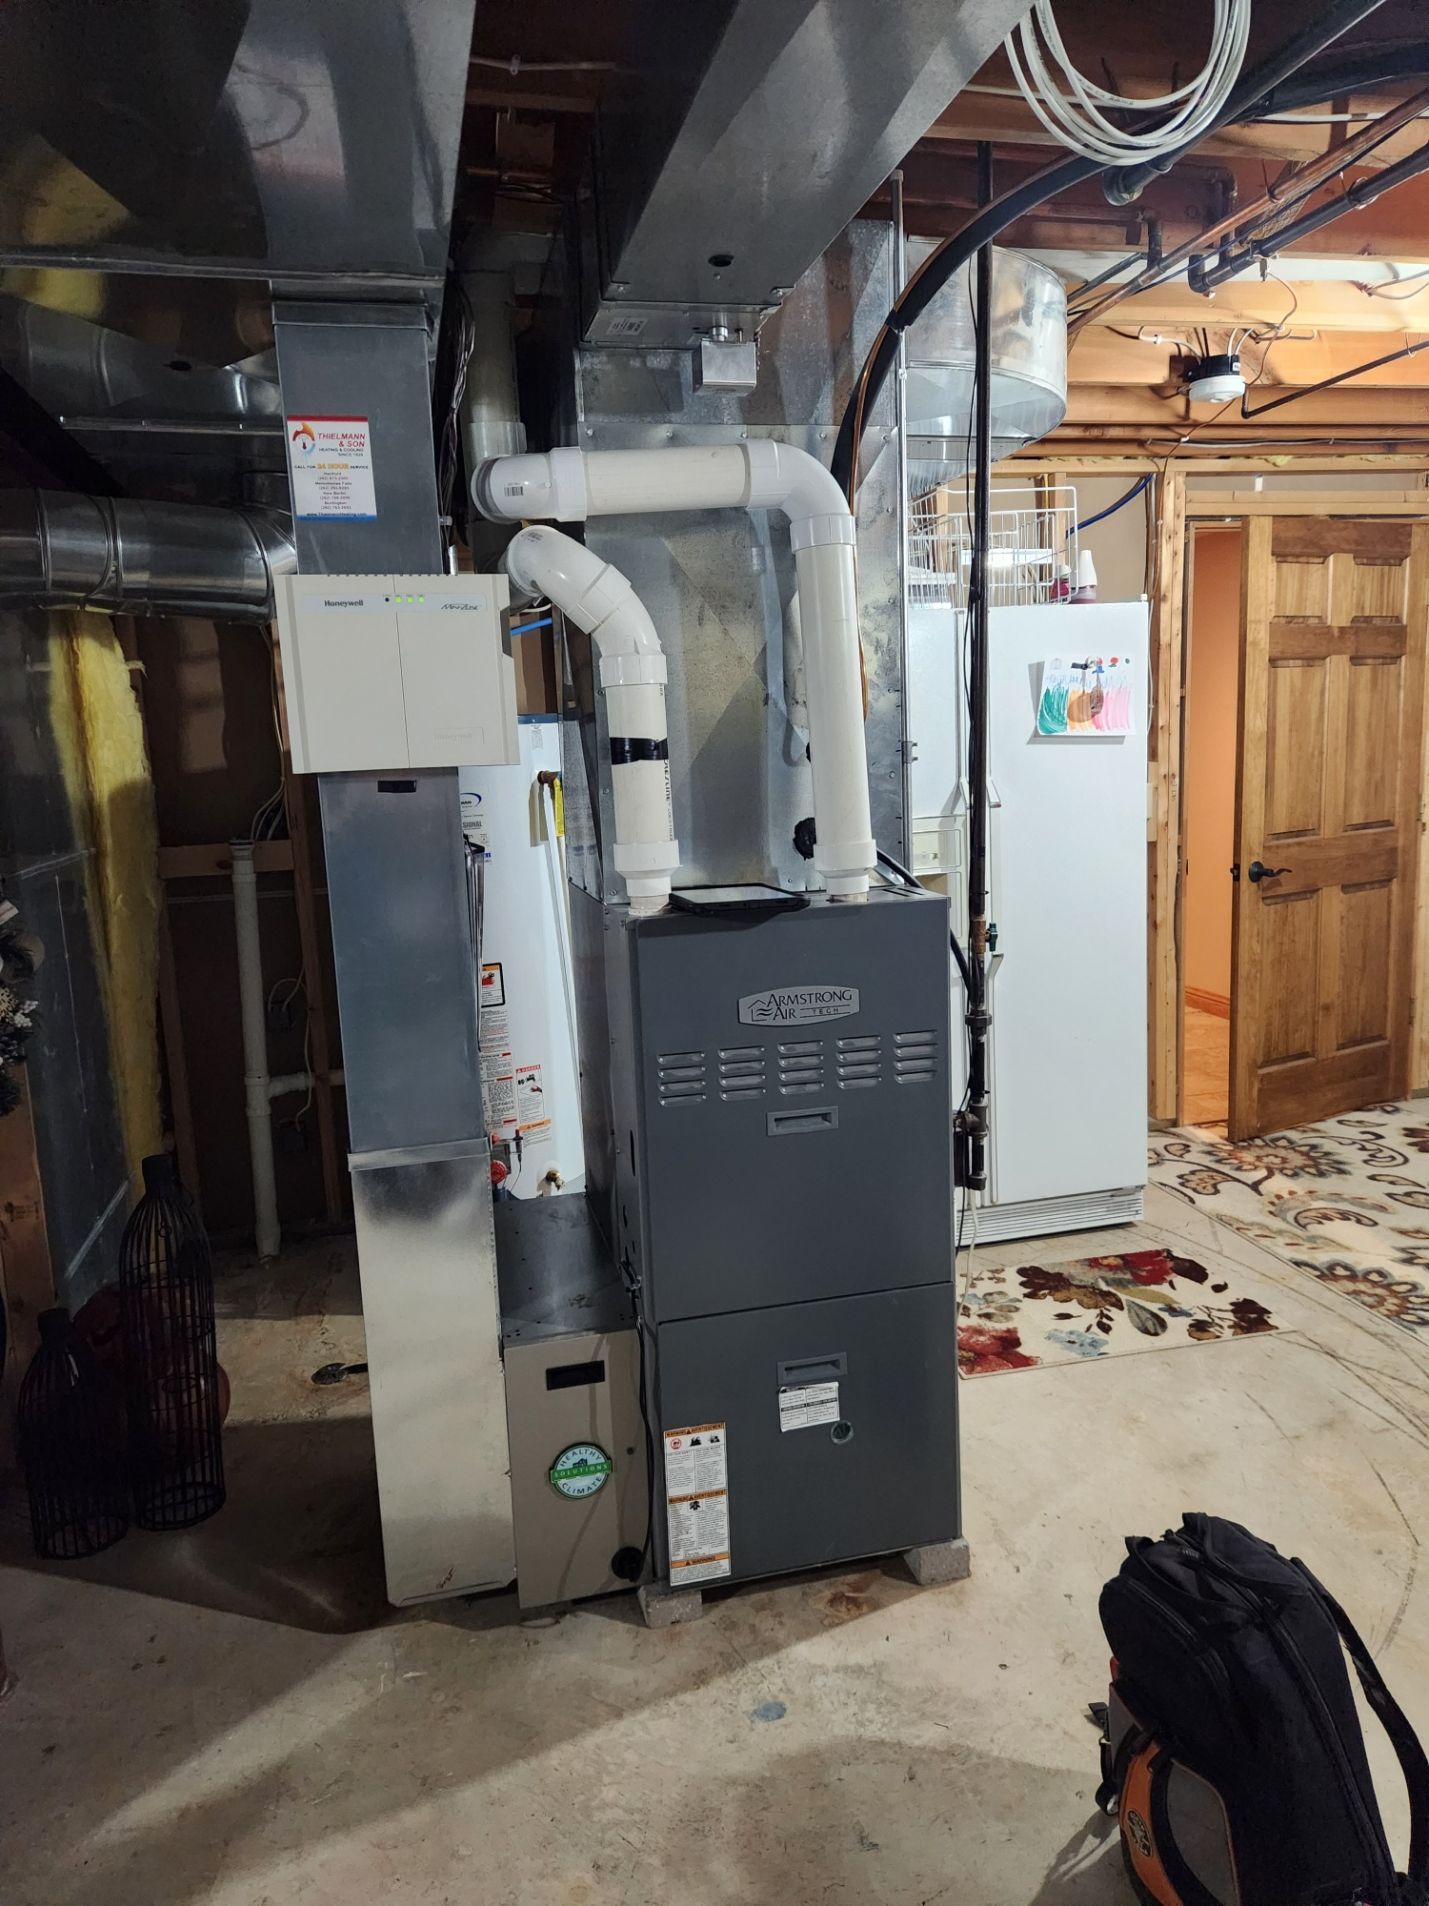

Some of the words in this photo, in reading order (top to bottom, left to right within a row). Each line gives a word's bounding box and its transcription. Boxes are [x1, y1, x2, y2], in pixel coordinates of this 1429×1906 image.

[767, 989, 852, 1007] ARMSTRONG
[773, 1007, 797, 1020] AIR
[812, 1007, 839, 1015] TECH
[560, 1449, 601, 1467] HEALTHY
[554, 1464, 608, 1478] SOLUTIONS
[562, 1477, 602, 1494] CLIMATE
